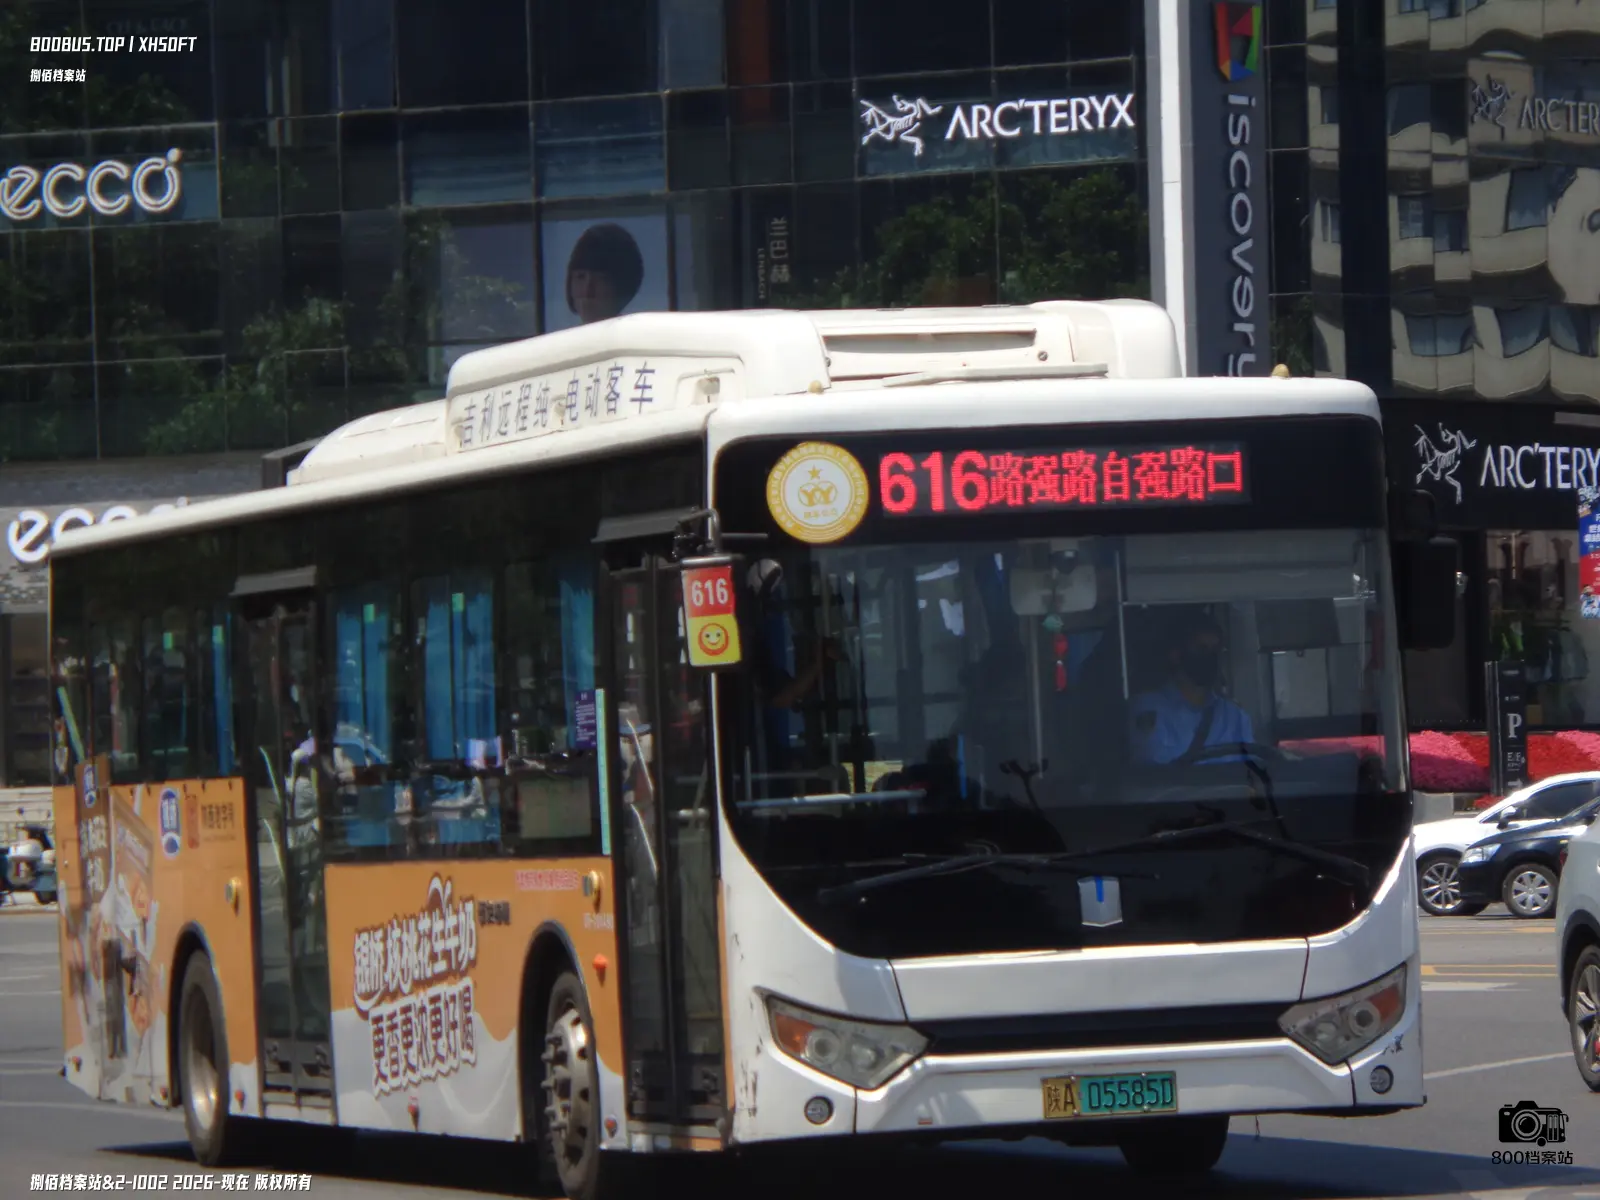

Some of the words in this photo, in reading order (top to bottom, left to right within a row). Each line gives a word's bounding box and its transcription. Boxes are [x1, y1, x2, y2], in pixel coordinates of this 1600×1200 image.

[945, 93, 1137, 140] ARC'TERYX
[0, 147, 183, 220] ecco
[691, 577, 728, 608] 616
[1507, 713, 1522, 738] P
[1088, 1077, 1174, 1110] 05585D
